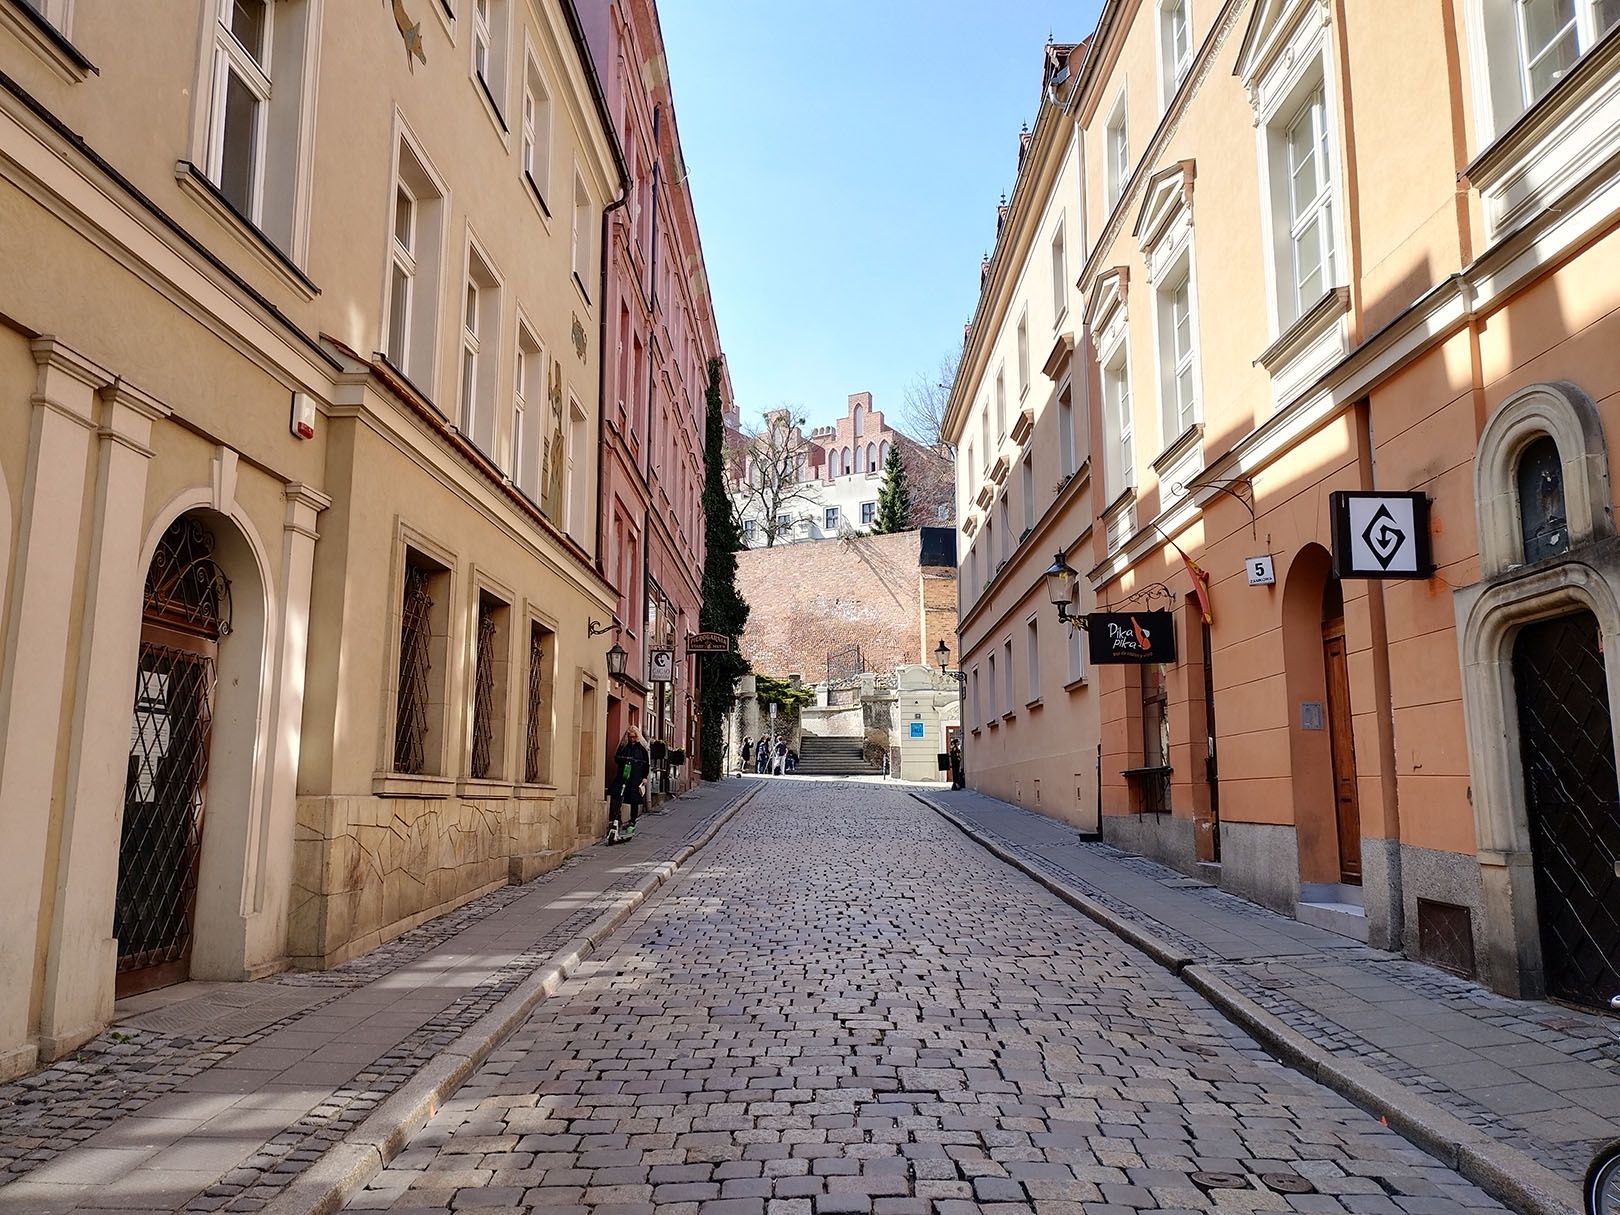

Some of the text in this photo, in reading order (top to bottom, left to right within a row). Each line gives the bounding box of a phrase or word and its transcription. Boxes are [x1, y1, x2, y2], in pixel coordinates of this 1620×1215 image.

[1255, 562, 1265, 577] 5
[1107, 622, 1134, 639] Pika
[1112, 637, 1137, 650] pika
